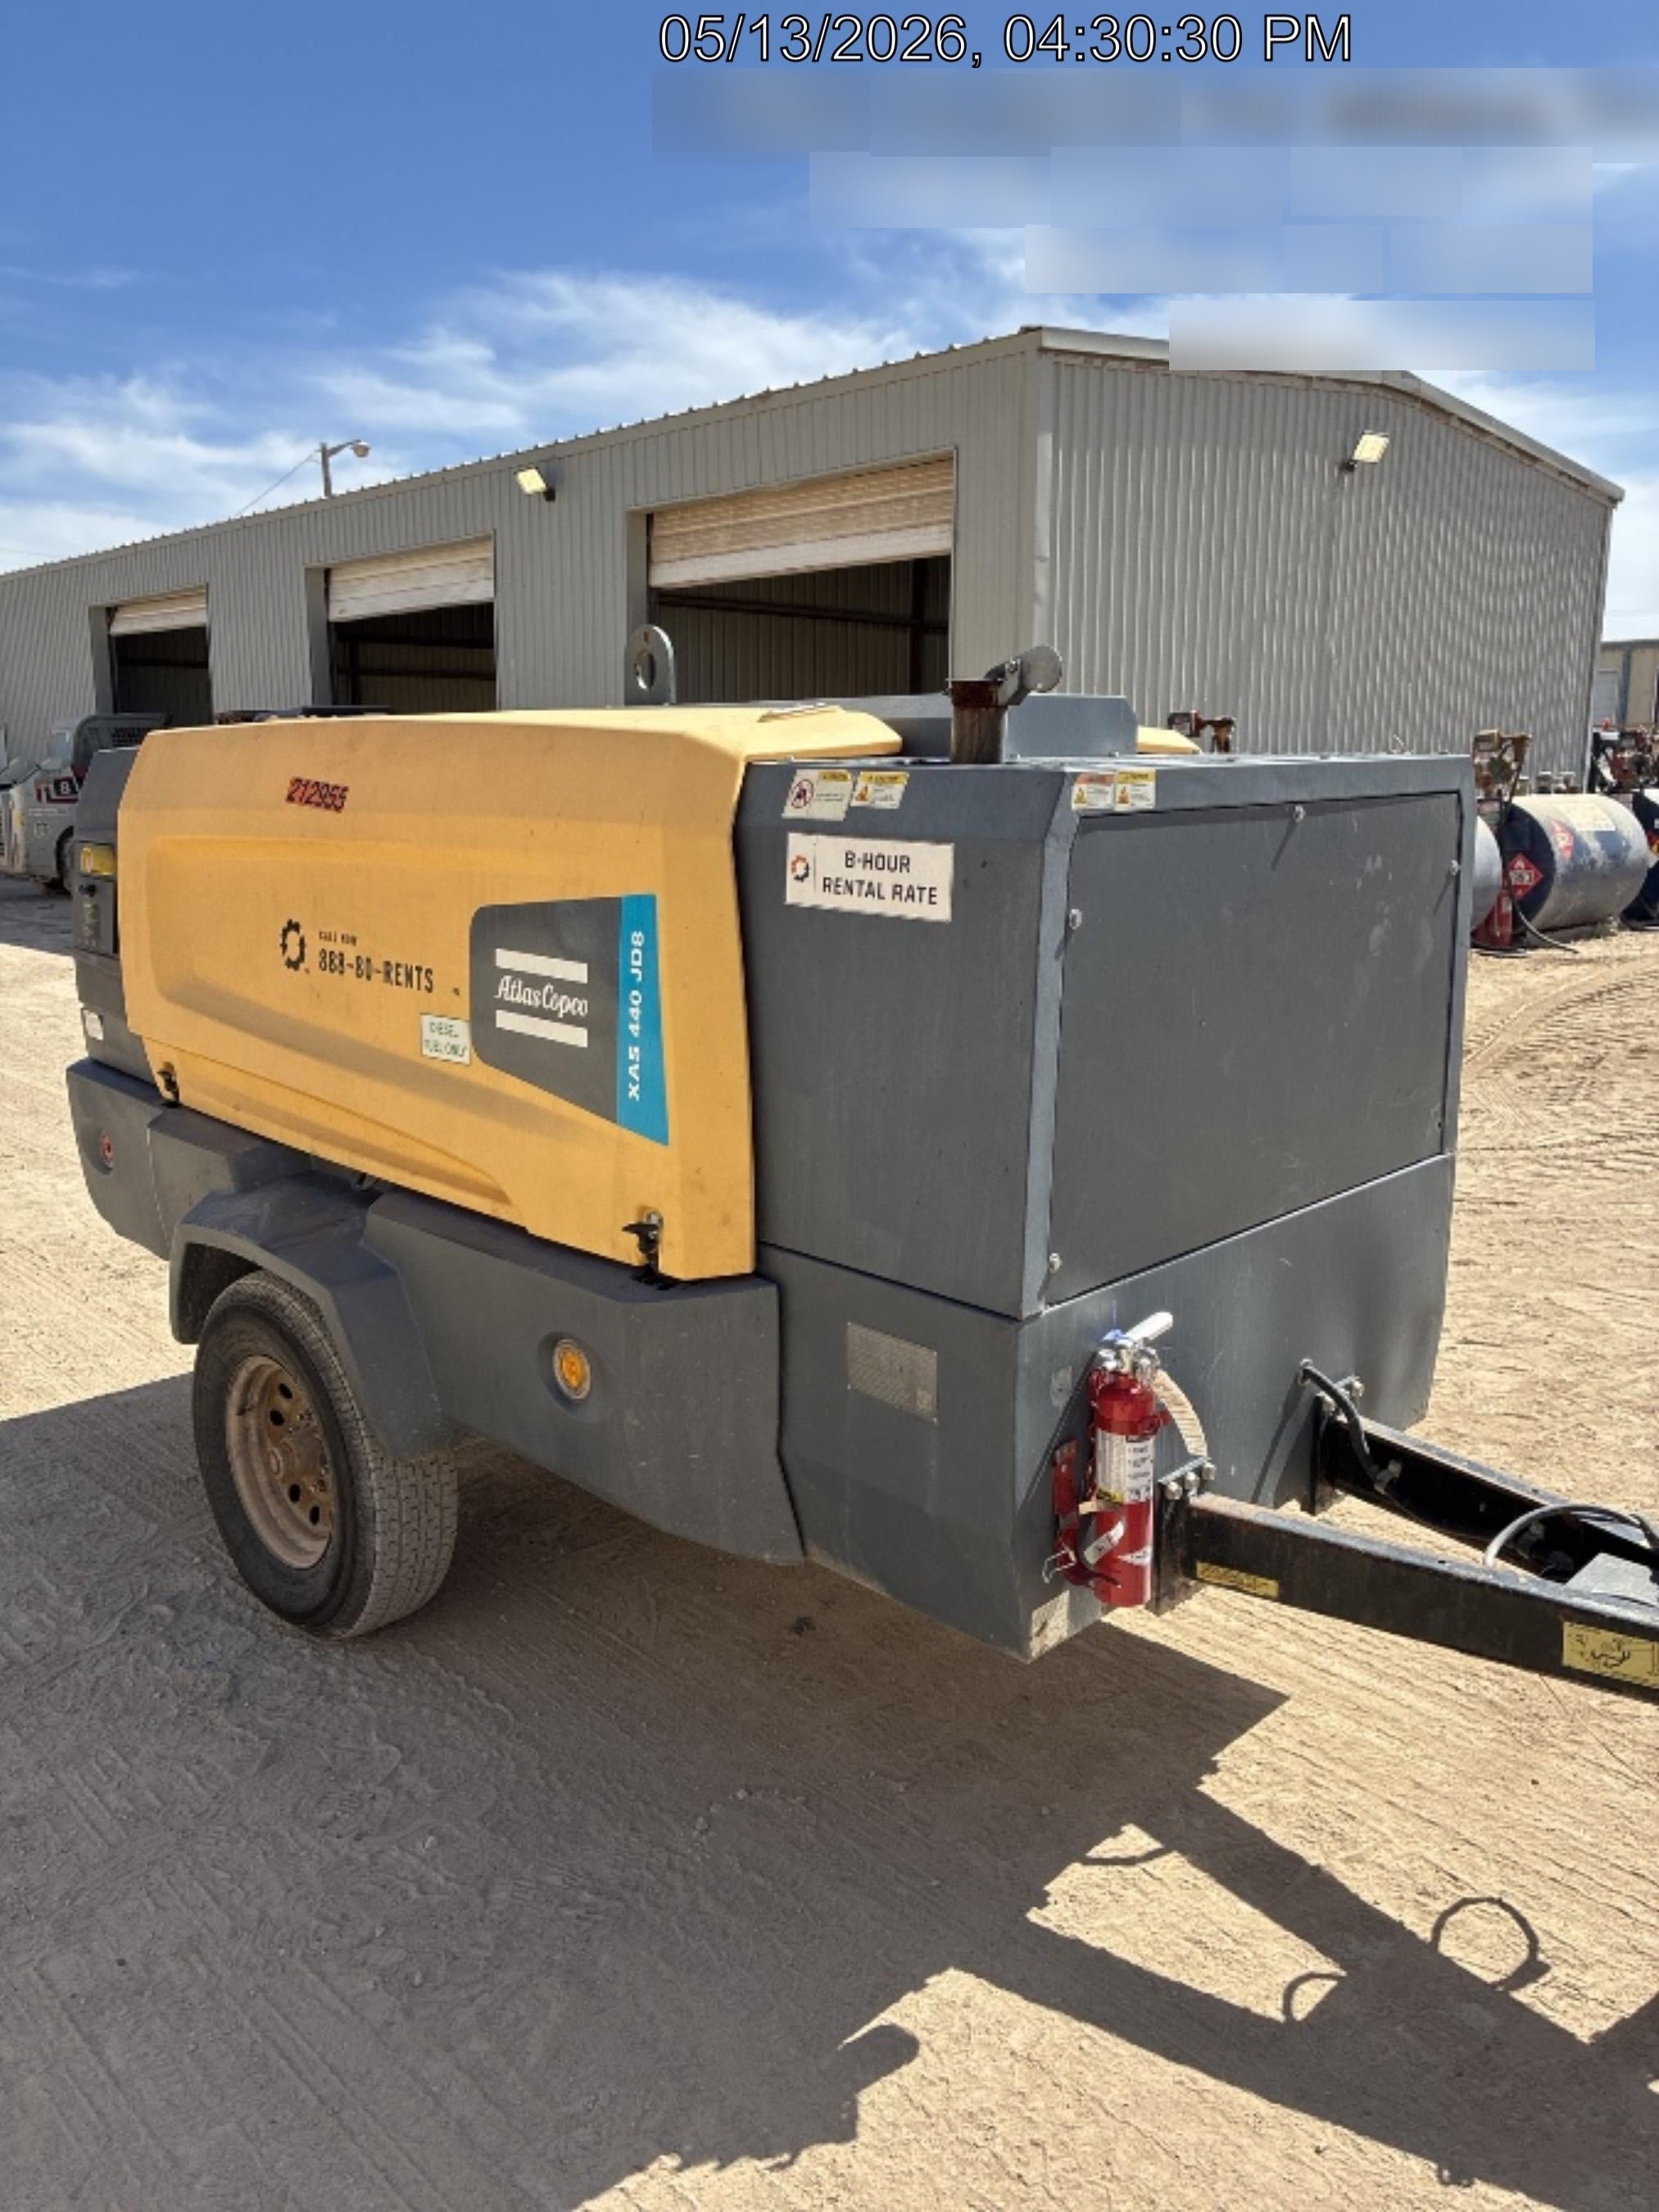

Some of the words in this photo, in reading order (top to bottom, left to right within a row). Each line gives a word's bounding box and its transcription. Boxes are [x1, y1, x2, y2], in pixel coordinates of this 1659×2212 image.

[823, 877, 886, 900] RENTAL
[891, 884, 938, 905] RATE
[630, 931, 645, 982] JD8
[493, 975, 541, 1009] Atlas
[542, 983, 588, 1018] Copco
[628, 990, 642, 1038] 440
[628, 1045, 640, 1101] XAS
